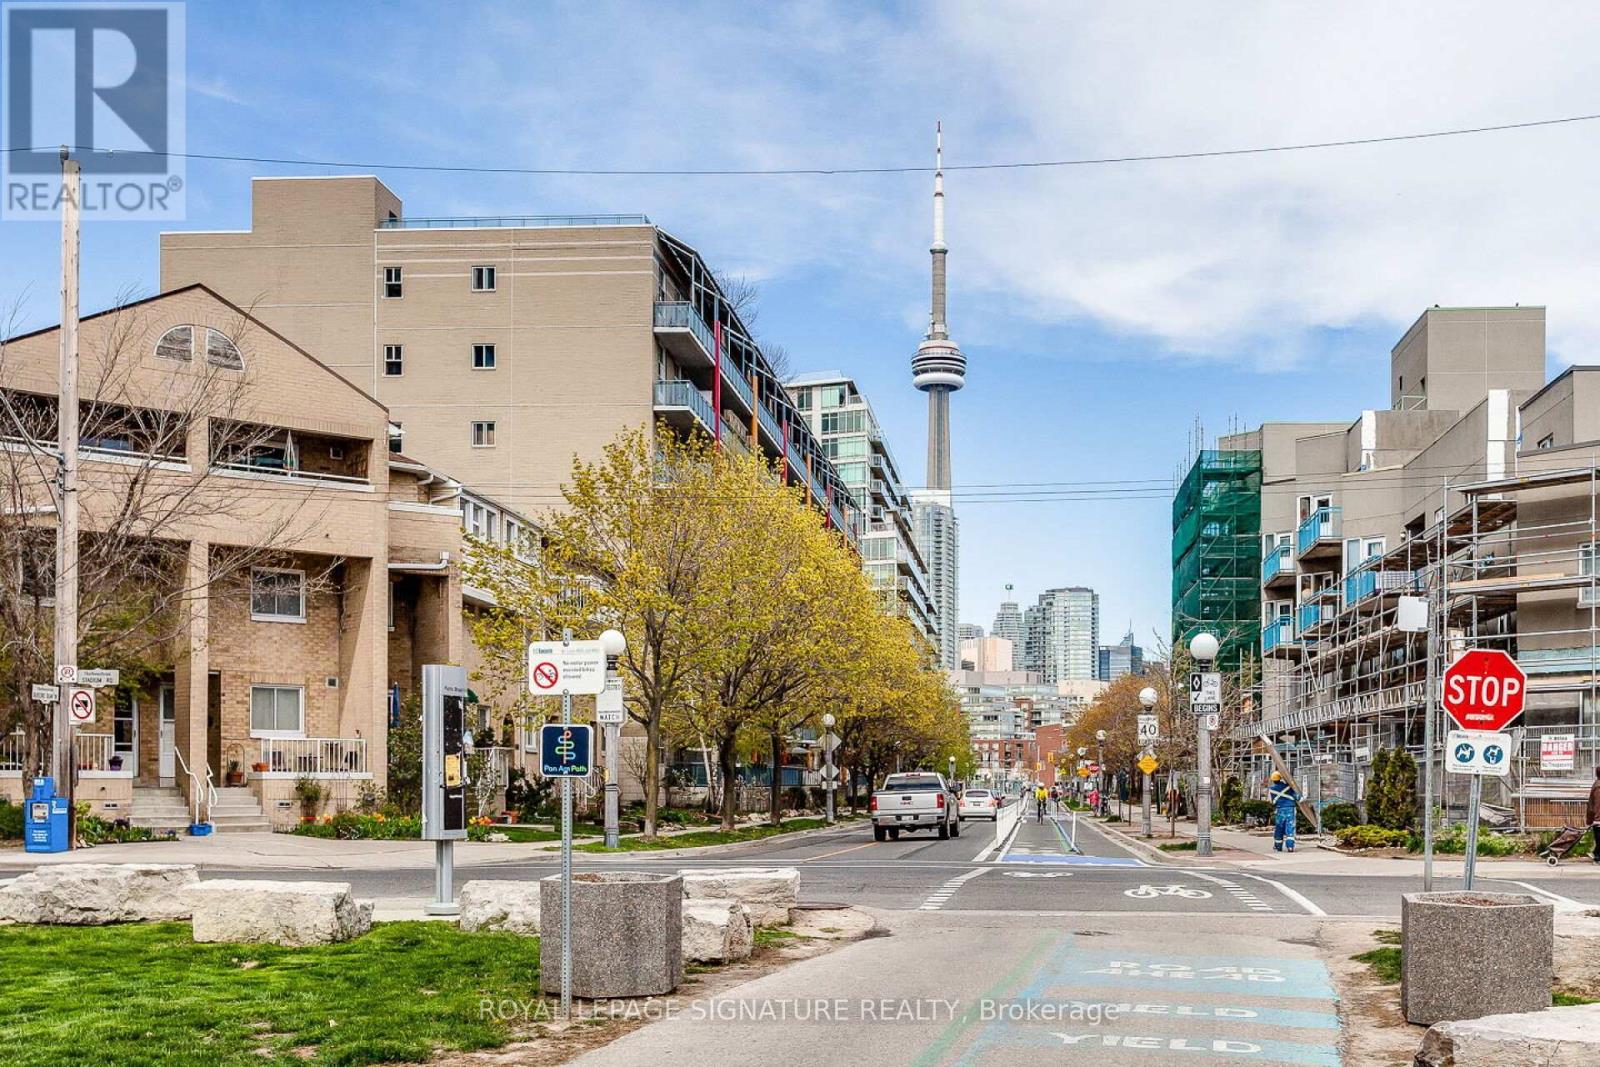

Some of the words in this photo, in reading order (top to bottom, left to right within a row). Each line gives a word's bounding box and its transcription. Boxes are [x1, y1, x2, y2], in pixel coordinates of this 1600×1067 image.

[1447, 674, 1521, 707] STOP
[1193, 704, 1218, 712] BEGINS
[1140, 724, 1157, 736] 40
[543, 764, 558, 772] Pan
[571, 765, 587, 773] Path
[1049, 1031, 1263, 1054] YIELD
